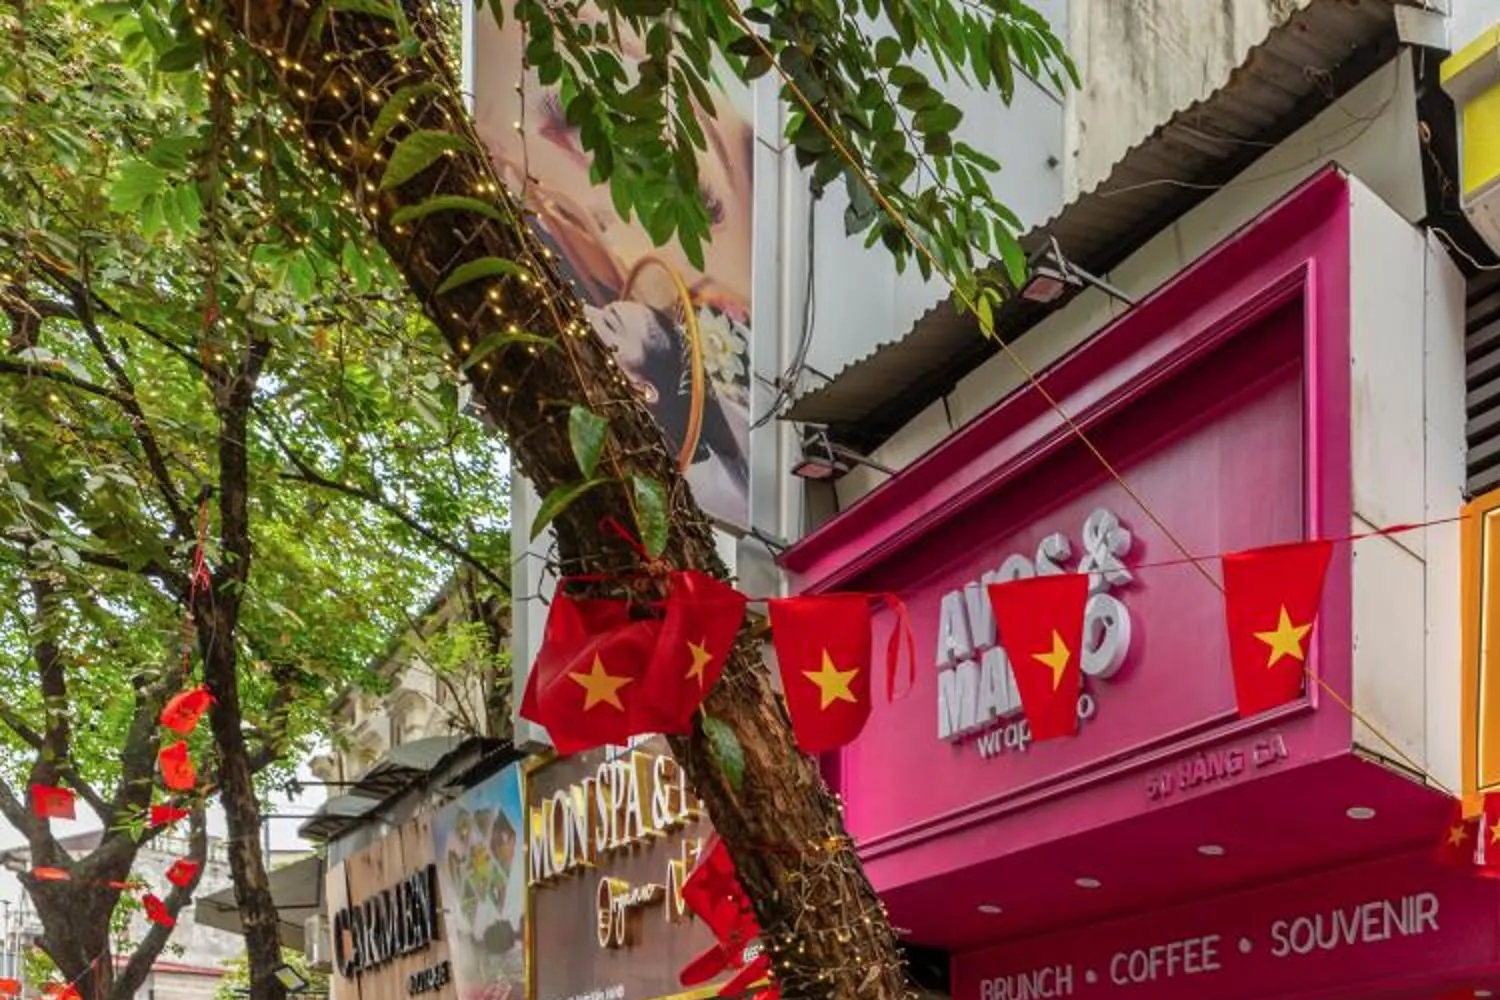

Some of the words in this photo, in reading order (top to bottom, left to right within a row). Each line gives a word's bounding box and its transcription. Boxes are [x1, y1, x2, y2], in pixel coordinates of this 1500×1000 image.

[937, 592, 1131, 741] MAO
[528, 778, 597, 888] MON
[596, 751, 648, 852] SPA
[1110, 935, 1222, 986] COFFEE
[1271, 892, 1440, 959] SOUVENIR
